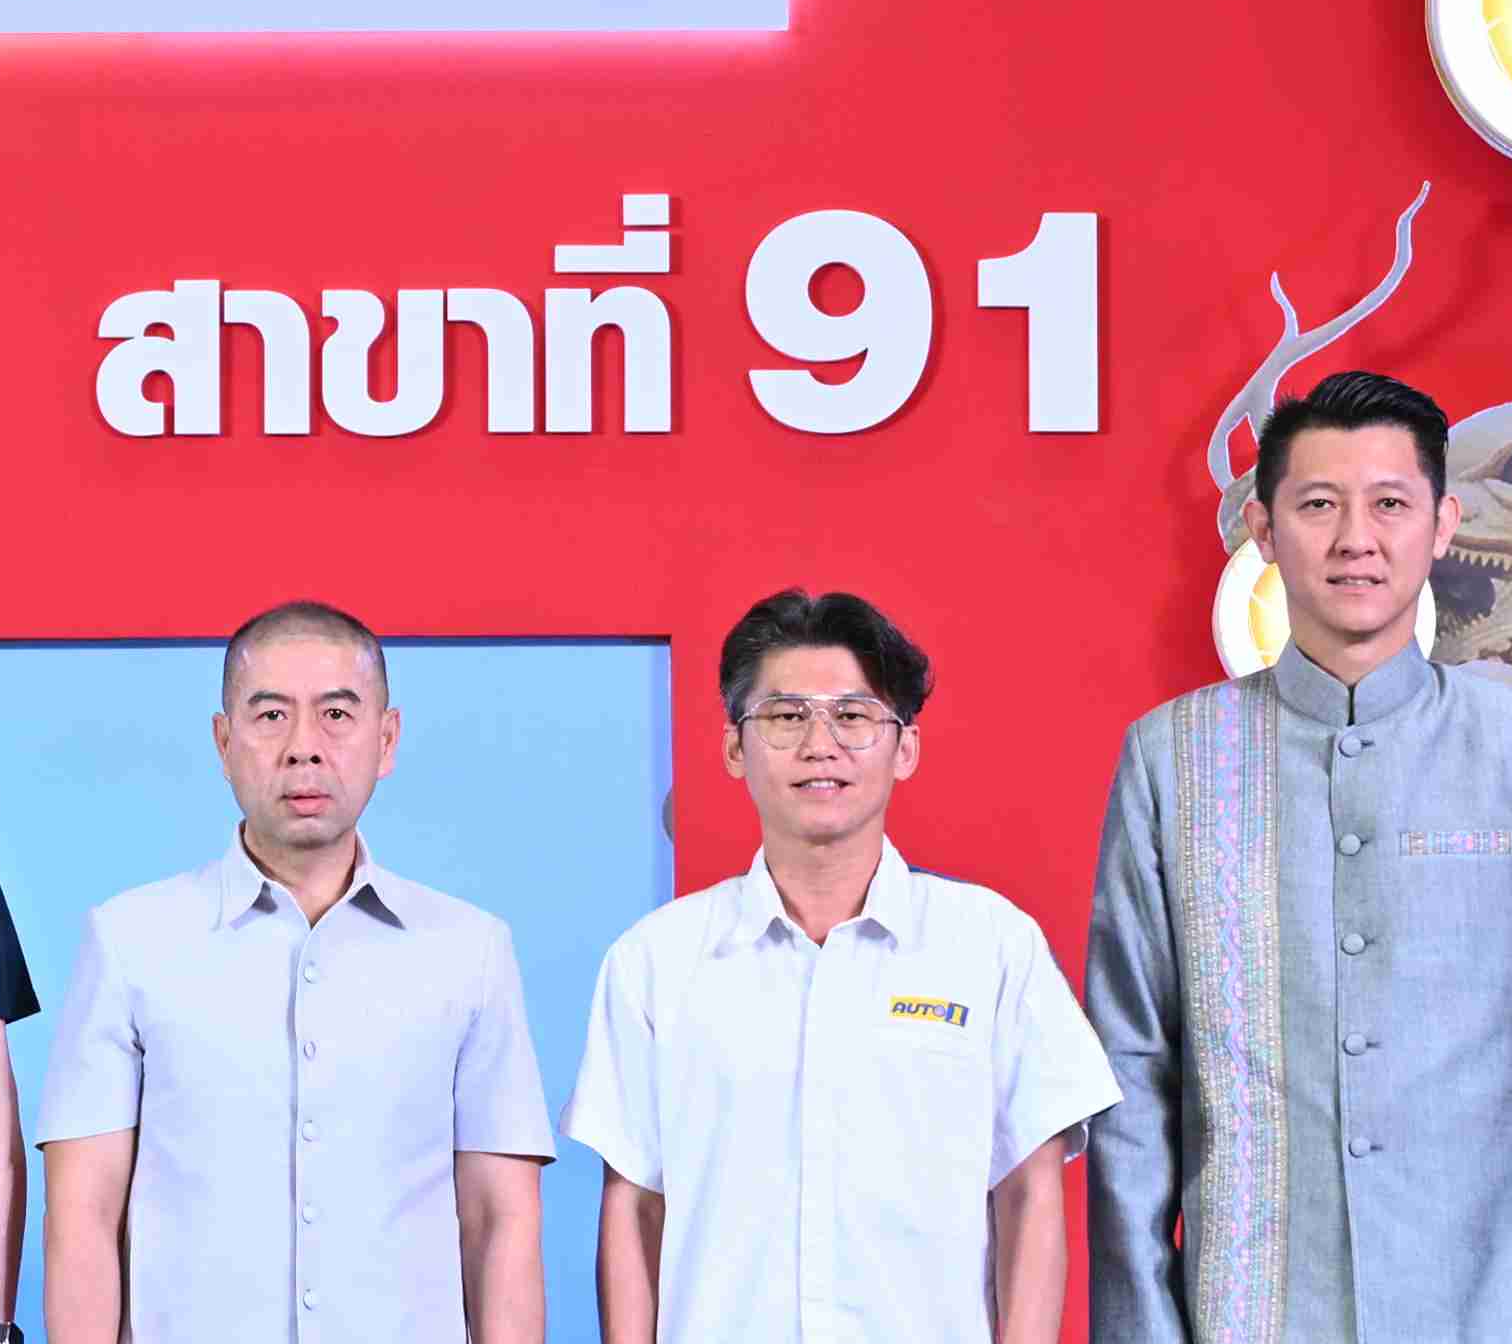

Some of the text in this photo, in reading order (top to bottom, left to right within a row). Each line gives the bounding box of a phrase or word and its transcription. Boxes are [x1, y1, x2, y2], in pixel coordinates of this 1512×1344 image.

[95, 194, 671, 437] สาขาที่
[744, 209, 1100, 436] 91
